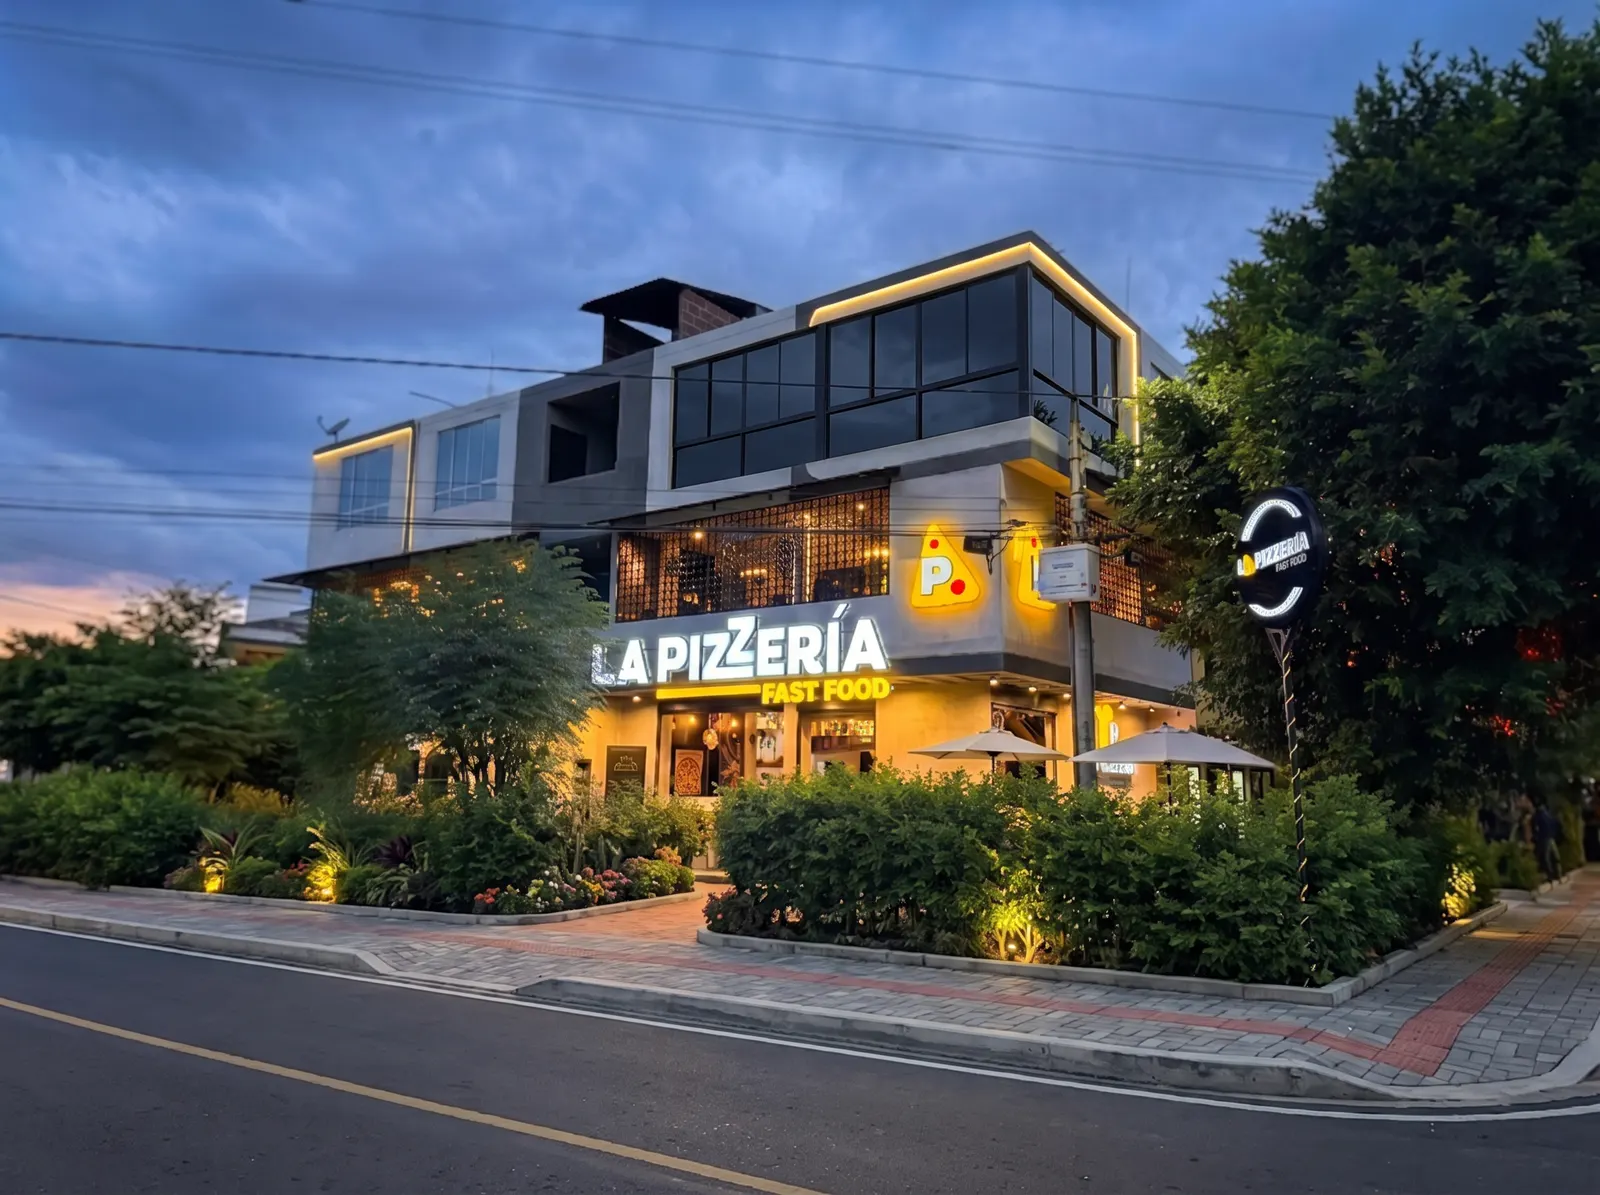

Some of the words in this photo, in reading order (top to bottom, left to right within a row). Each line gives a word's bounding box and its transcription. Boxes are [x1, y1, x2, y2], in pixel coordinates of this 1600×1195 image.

[920, 556, 954, 596] P
[1275, 560, 1290, 572] FAST
[1290, 553, 1307, 567] FOOD
[591, 639, 653, 687] LA
[657, 603, 891, 683] PIZZERÍA
[761, 679, 820, 705] FAST
[823, 678, 891, 702] FOOD
